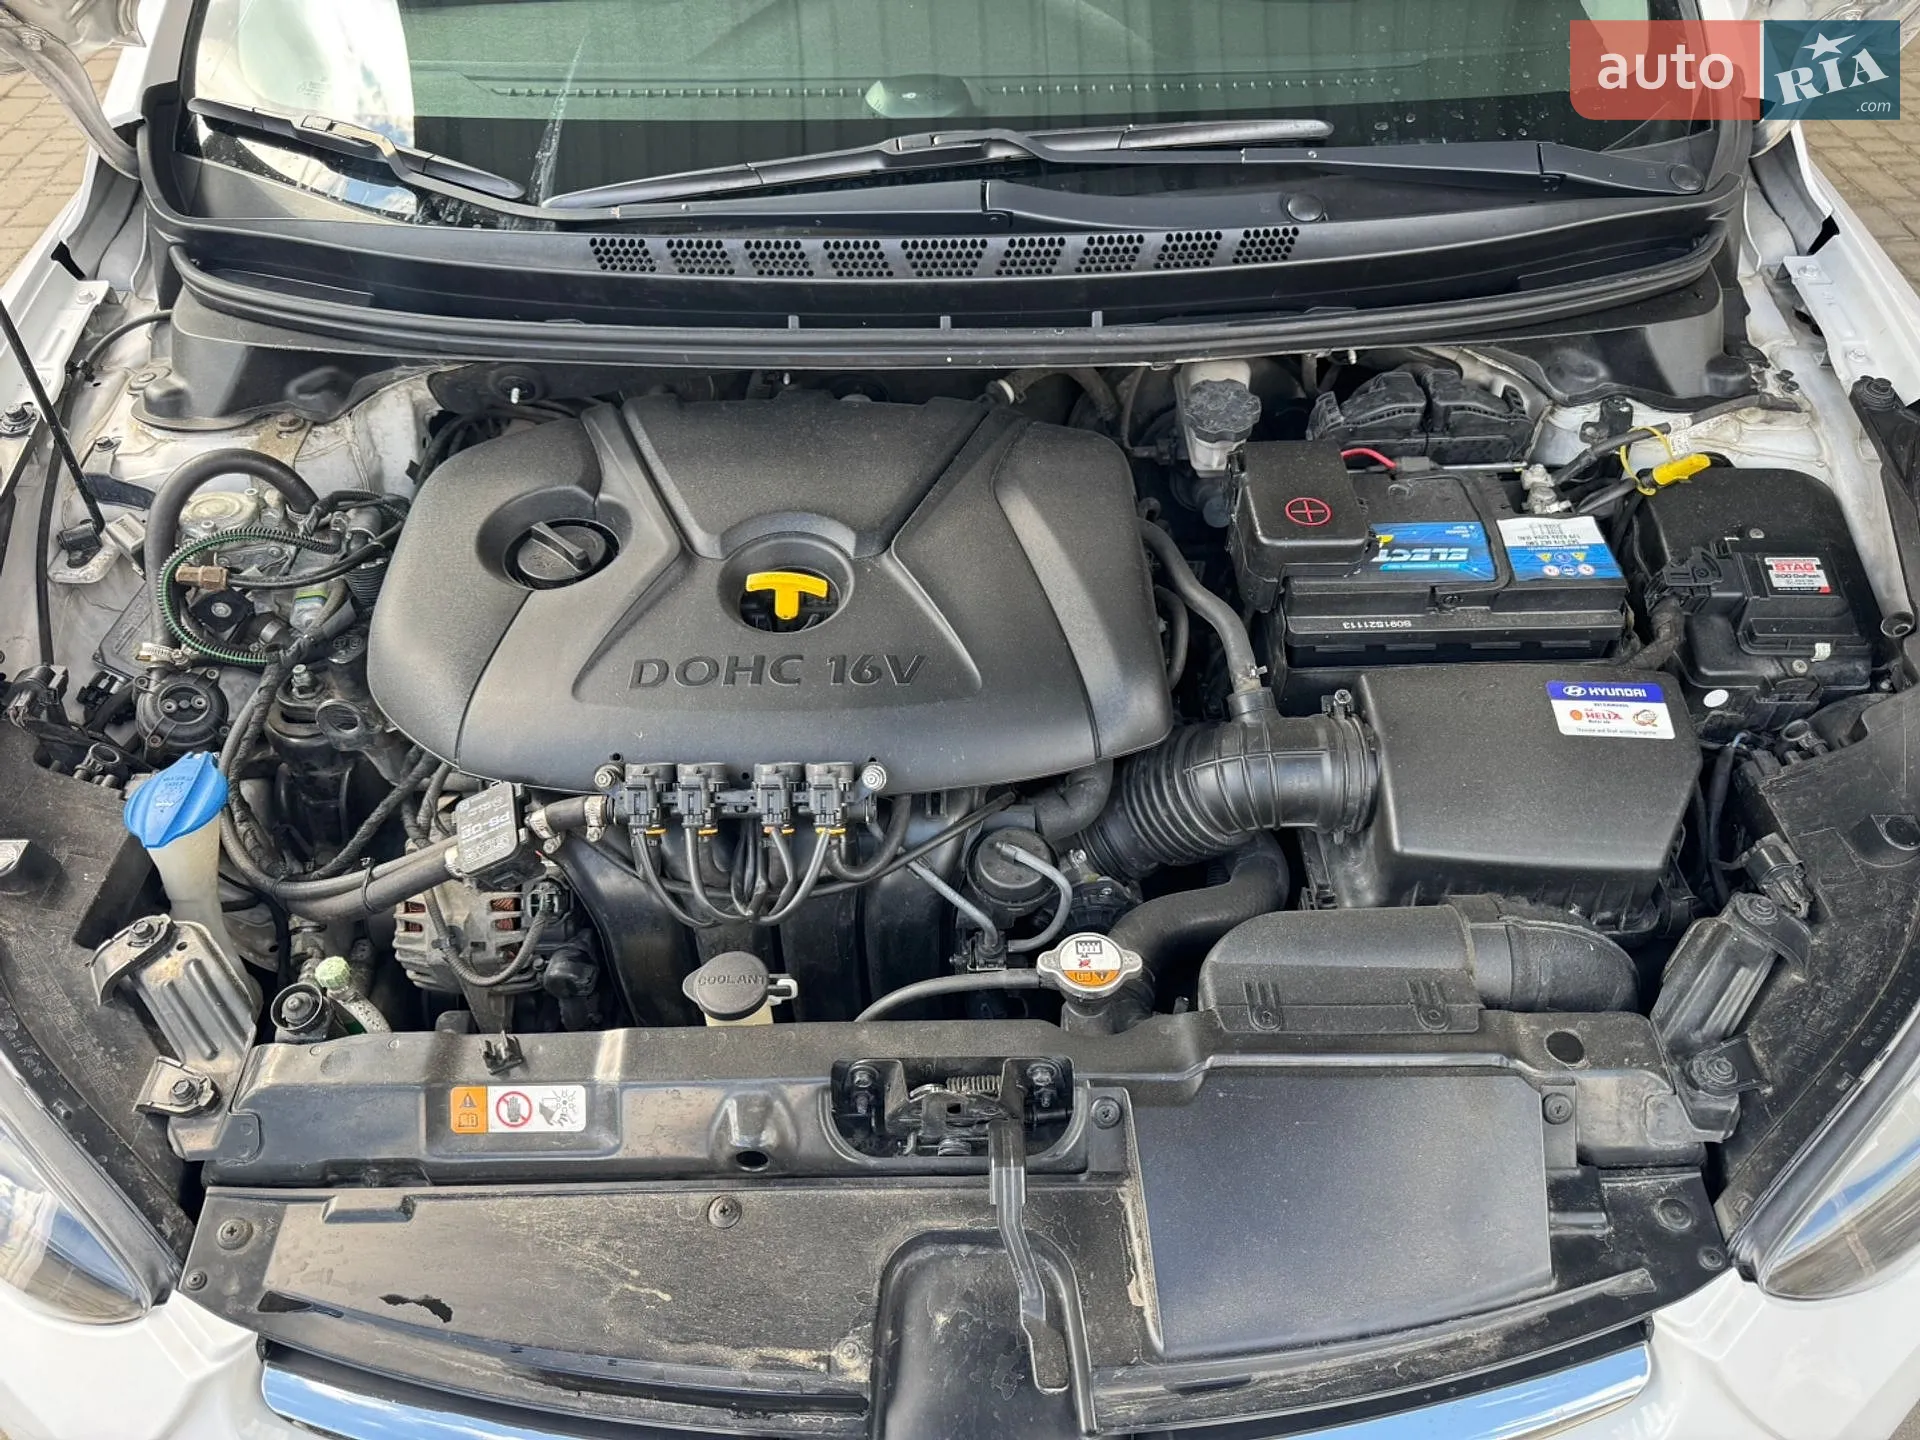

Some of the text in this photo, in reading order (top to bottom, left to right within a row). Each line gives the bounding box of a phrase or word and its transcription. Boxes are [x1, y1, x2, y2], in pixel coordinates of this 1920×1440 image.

[1775, 563, 1815, 571] STAG
[628, 653, 927, 691] DOHC 16V
[1588, 686, 1648, 698] HYUNDAI
[1584, 710, 1623, 720] HELIX
[698, 974, 765, 986] COOLANT
